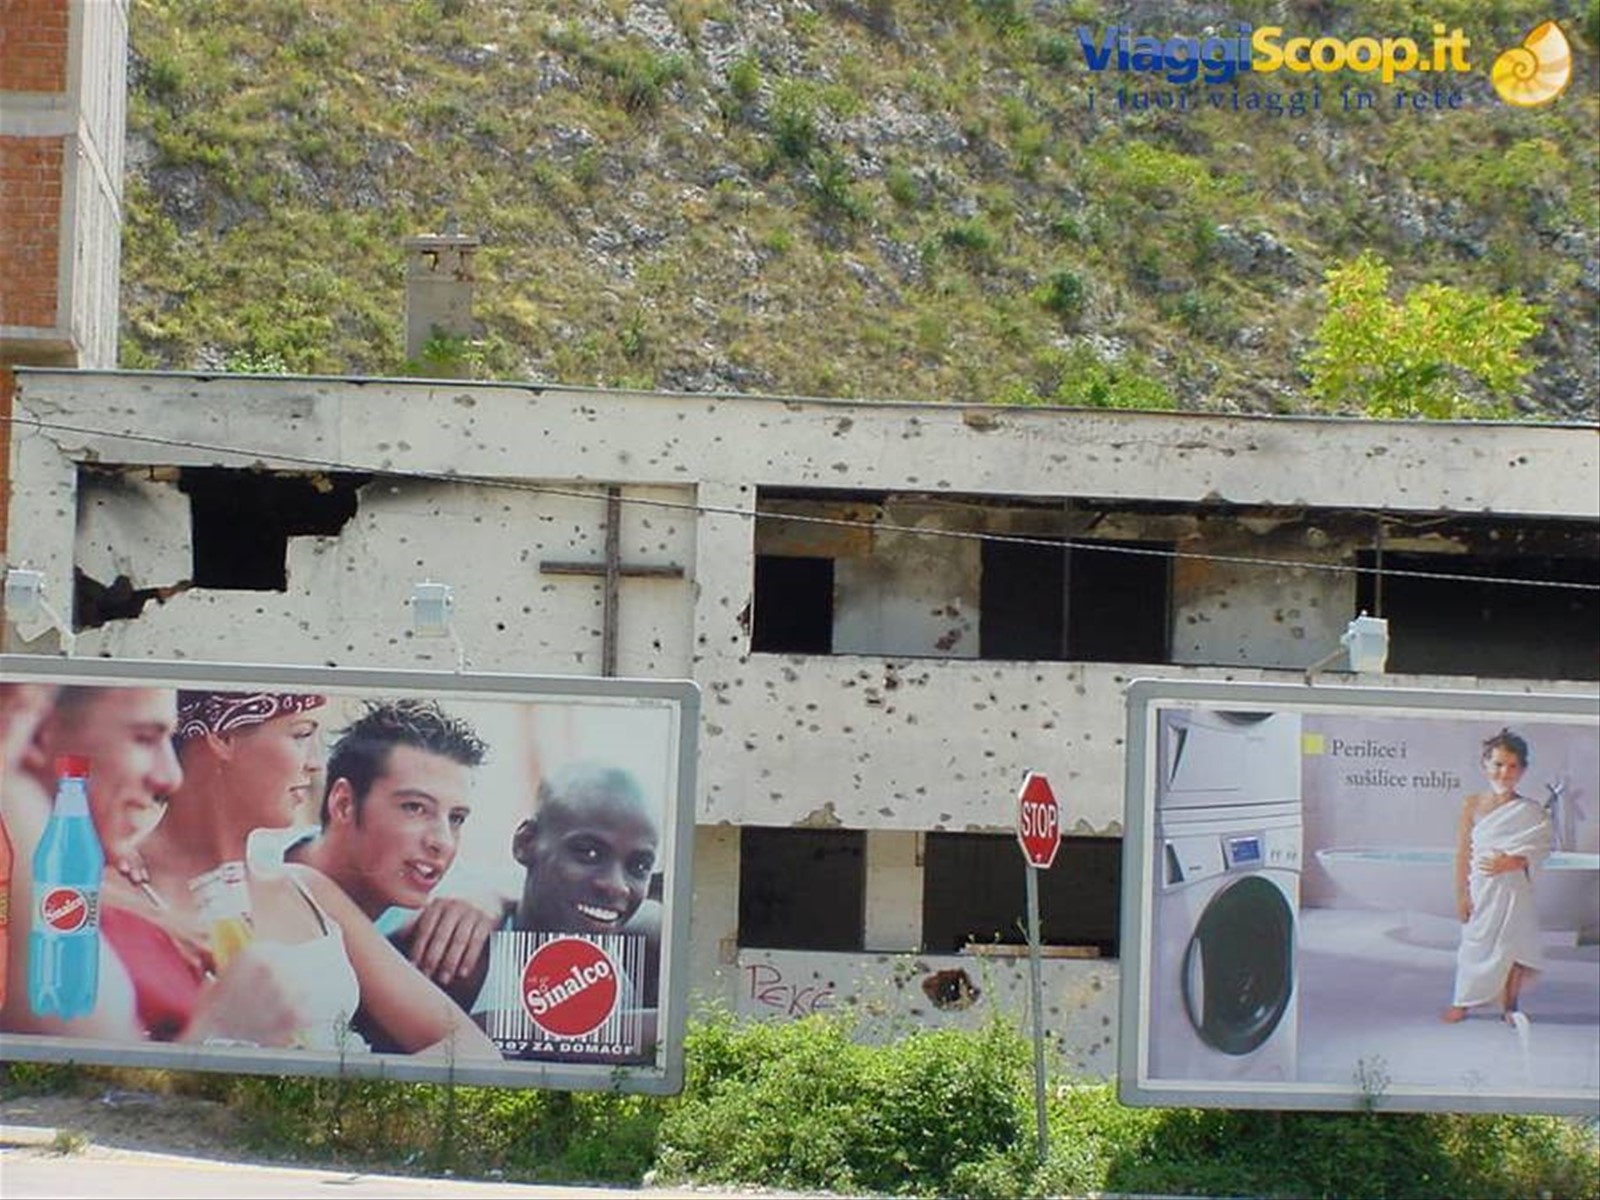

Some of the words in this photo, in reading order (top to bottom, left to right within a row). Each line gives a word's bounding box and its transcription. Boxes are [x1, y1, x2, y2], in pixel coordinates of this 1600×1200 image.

[1332, 739, 1397, 758] Perilice
[1401, 741, 1407, 758] i
[1412, 770, 1460, 792] rublja
[1023, 801, 1057, 838] STOP
[527, 959, 610, 1016] Sinalco
[532, 1042, 554, 1051] ZA
